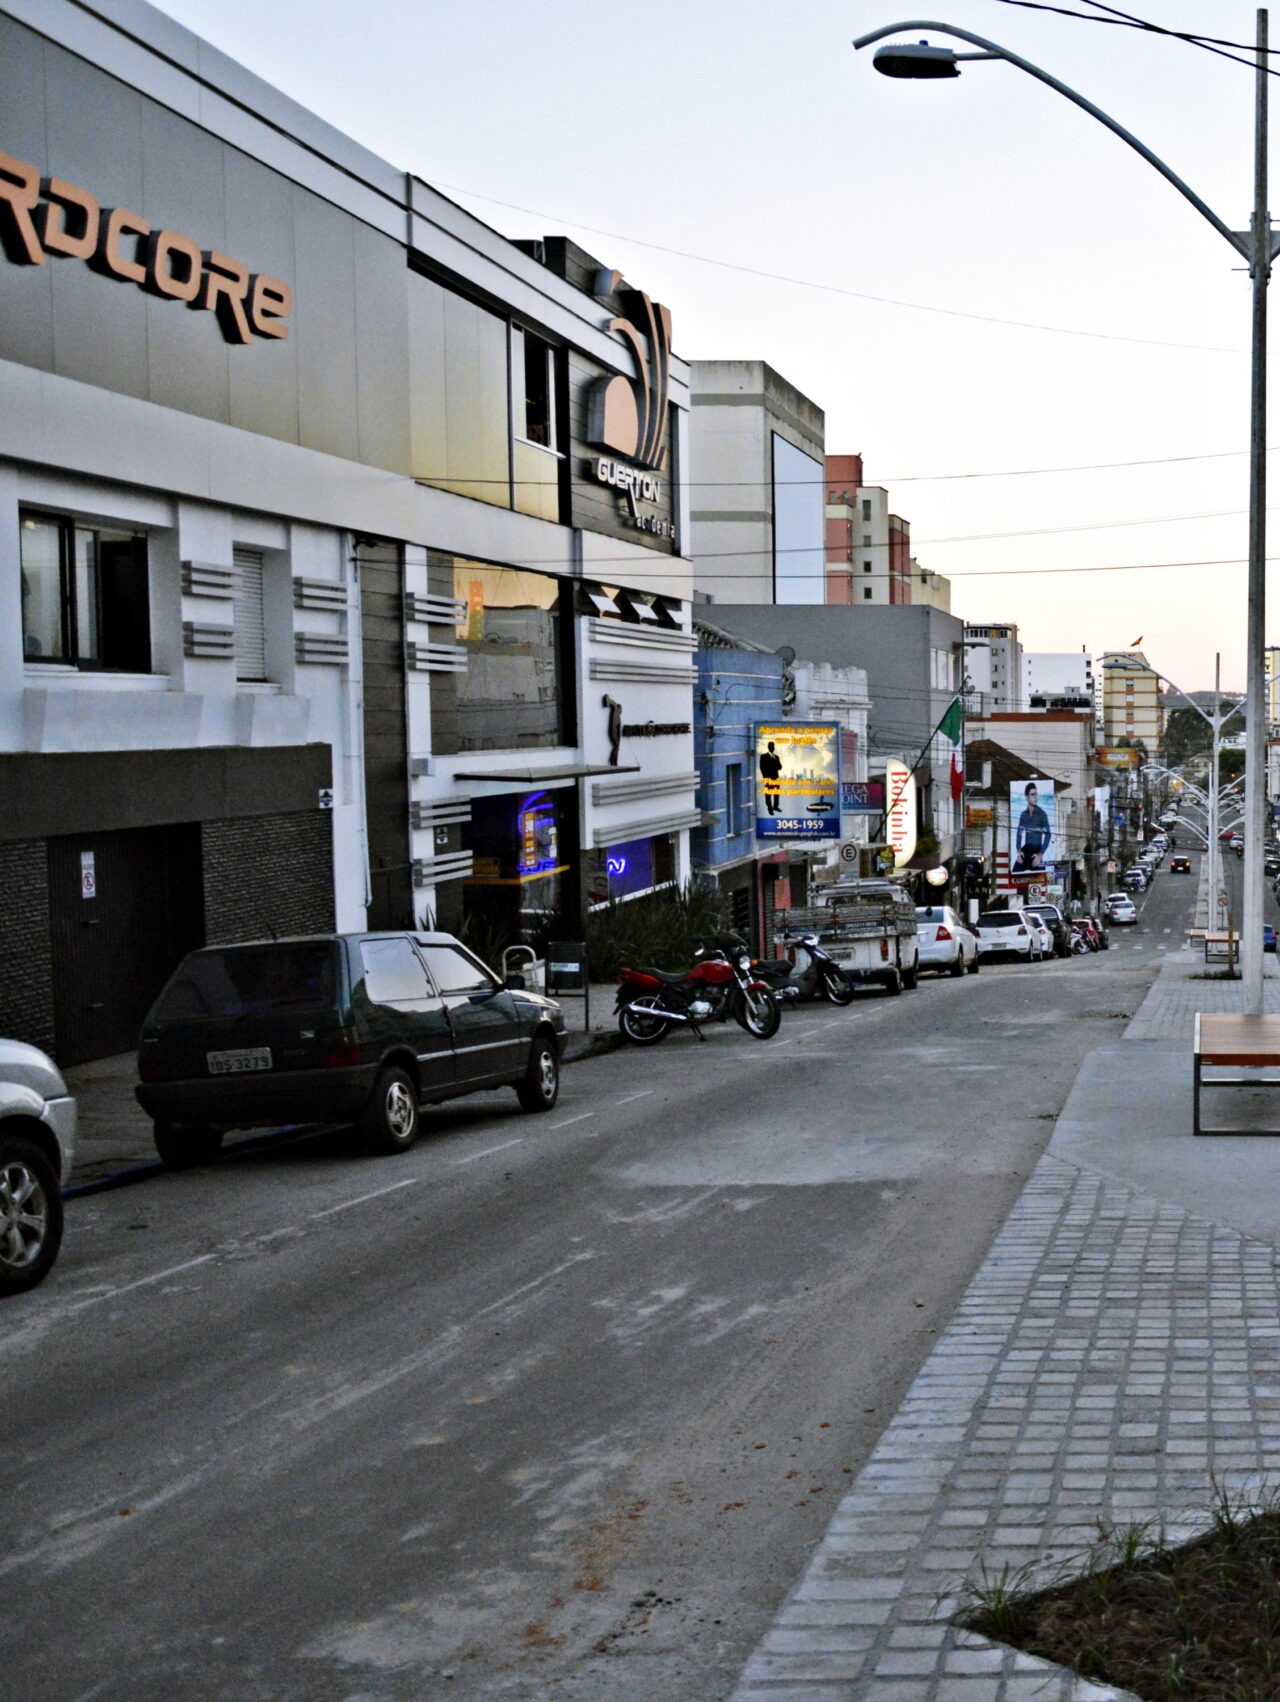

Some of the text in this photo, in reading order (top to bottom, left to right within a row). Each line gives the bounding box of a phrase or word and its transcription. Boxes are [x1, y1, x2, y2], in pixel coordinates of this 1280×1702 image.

[763, 787, 835, 797] Aulas particulares
[891, 771, 908, 853] Bokinha
[776, 820, 824, 829] 3045-1959
